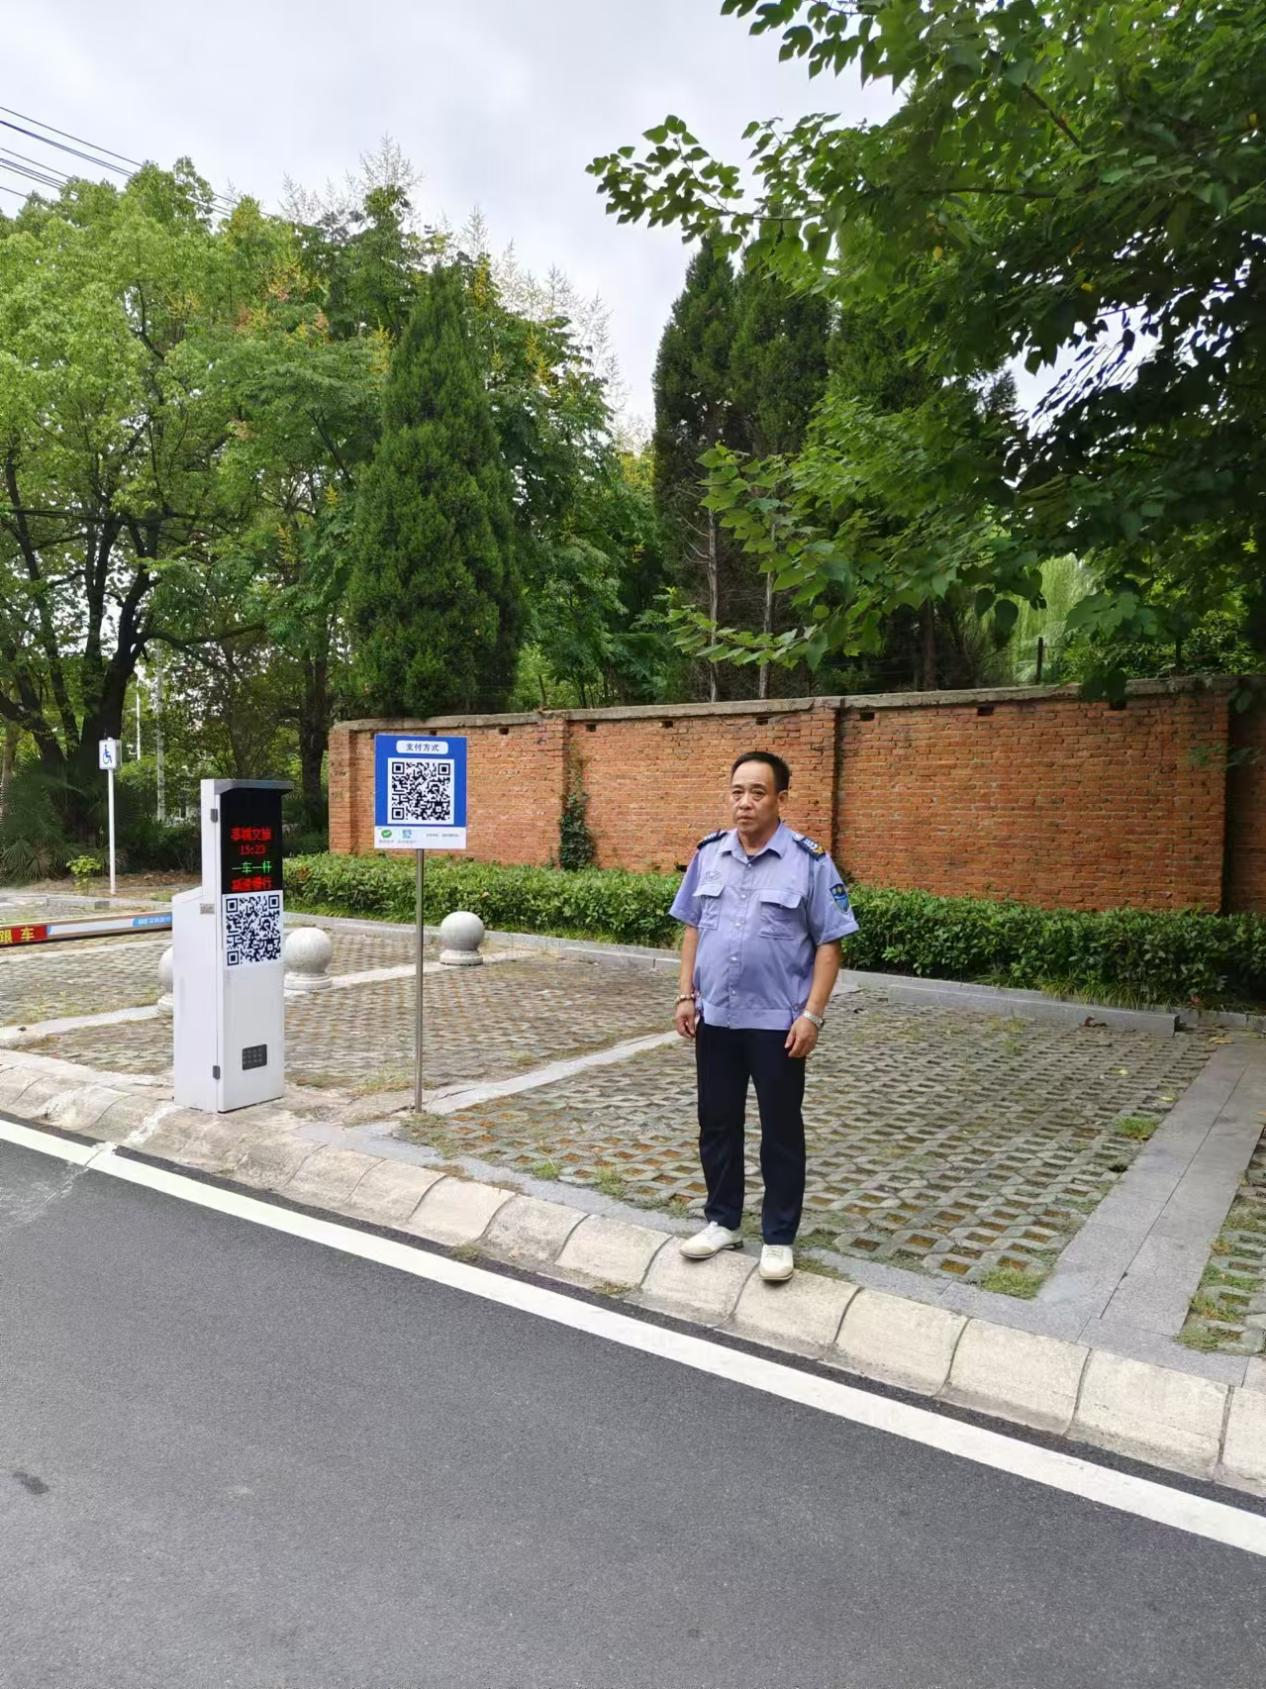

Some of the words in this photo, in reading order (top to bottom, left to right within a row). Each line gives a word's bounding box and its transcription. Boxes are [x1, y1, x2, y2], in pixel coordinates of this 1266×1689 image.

[406, 743, 440, 752] 支付方式
[232, 860, 272, 874] 一车一杆
